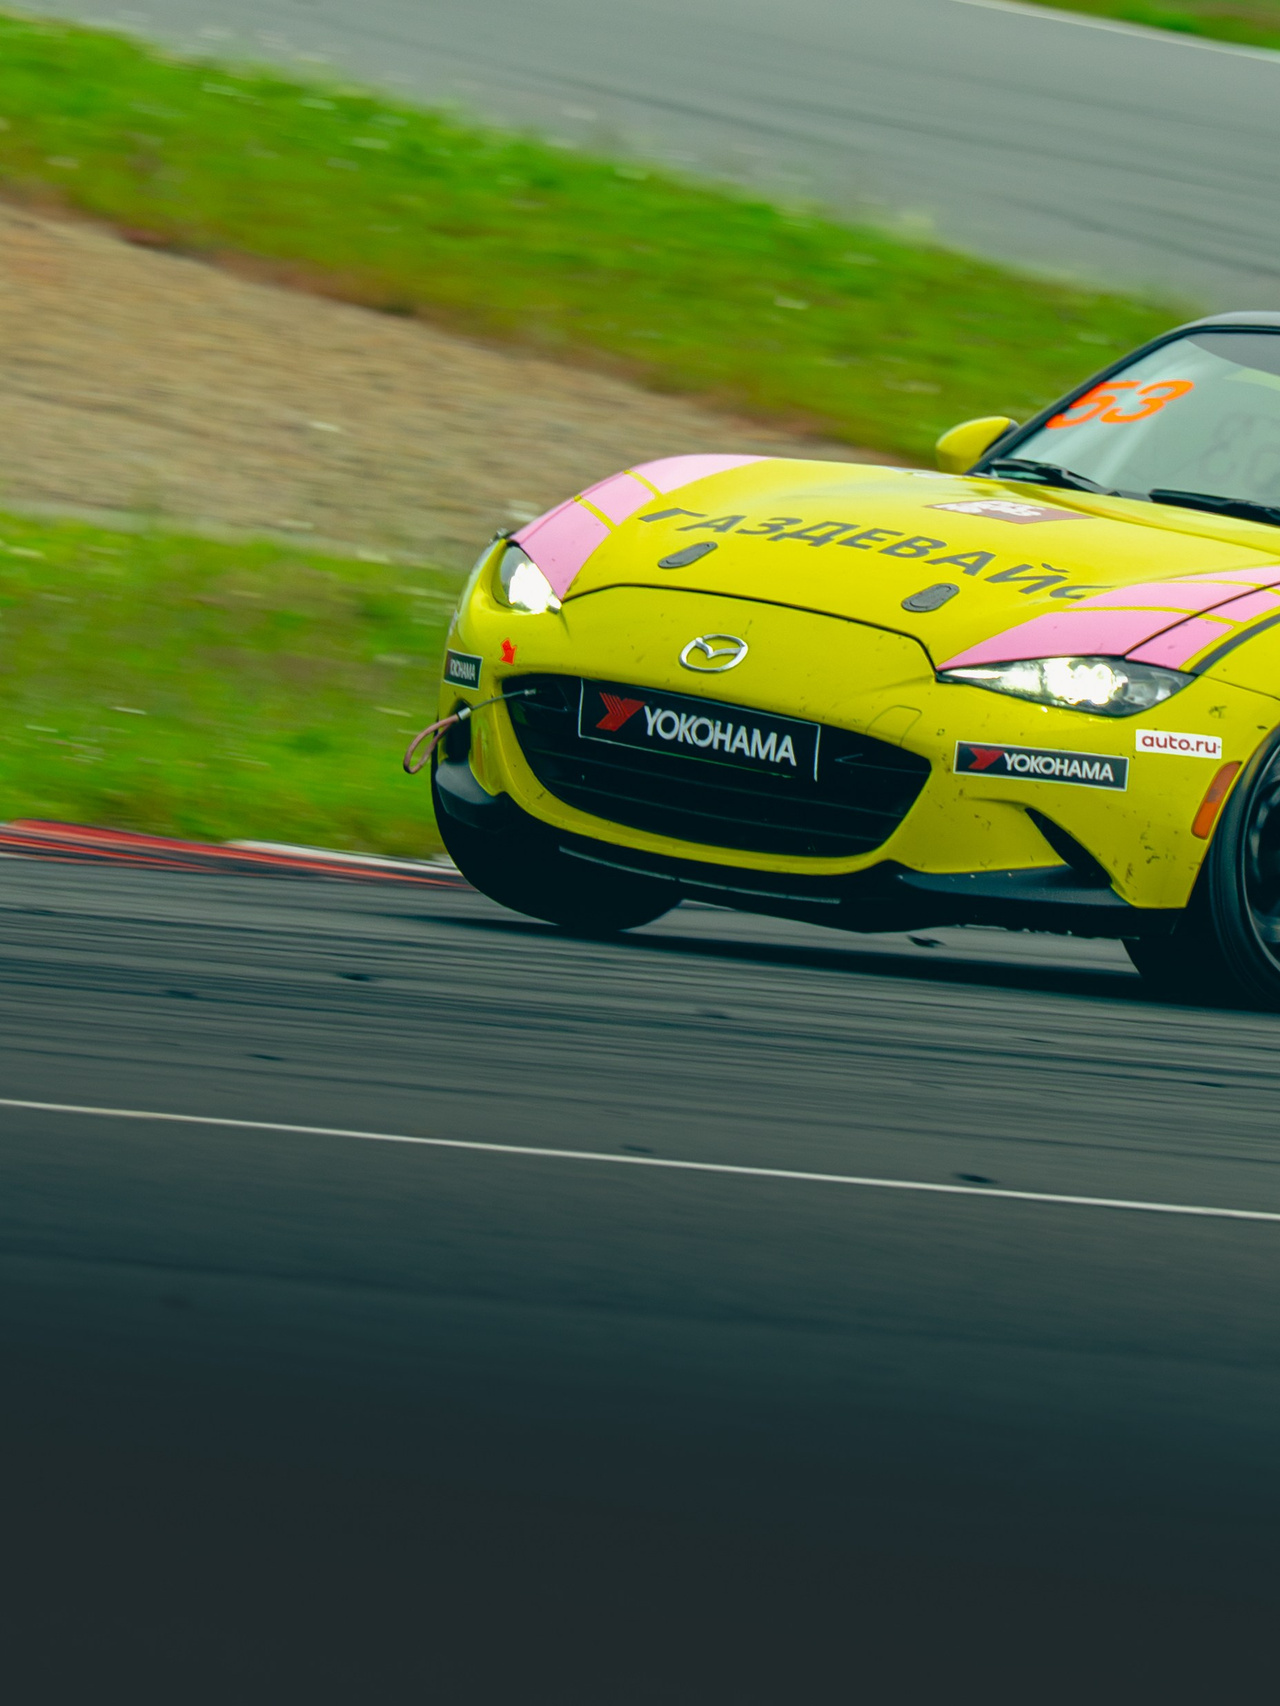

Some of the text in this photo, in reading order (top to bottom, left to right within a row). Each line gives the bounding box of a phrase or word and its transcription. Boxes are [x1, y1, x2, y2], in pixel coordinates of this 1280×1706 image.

[1045, 379, 1195, 429] 53
[638, 507, 1117, 600] ГАЗДЕВАЙС
[643, 705, 798, 767] YOKOHAMA
[1141, 735, 1218, 754] auto.ru
[1003, 752, 1115, 782] YOKOHAMA
